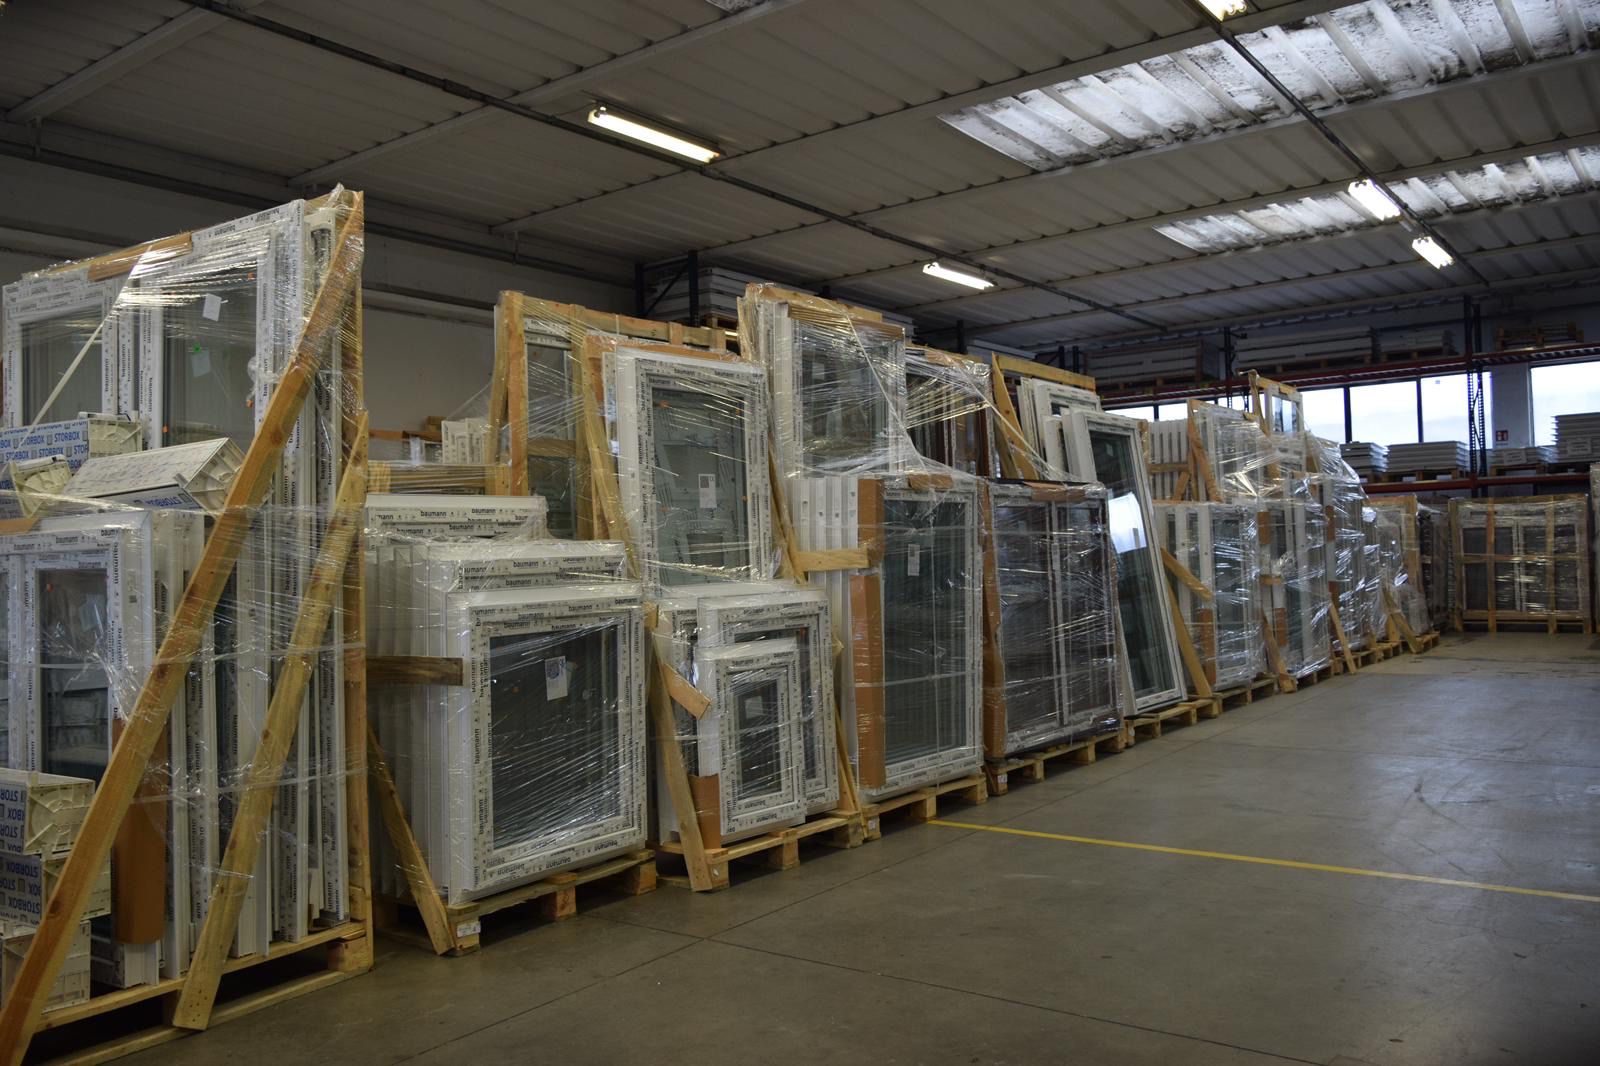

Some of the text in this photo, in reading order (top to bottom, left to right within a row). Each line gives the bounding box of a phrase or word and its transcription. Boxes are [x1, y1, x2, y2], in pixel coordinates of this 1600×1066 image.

[54, 431, 81, 442] STORBOX
[5, 450, 29, 460] STORBOX
[38, 447, 64, 458] STORBOX
[420, 510, 448, 518] baumann
[449, 524, 475, 532] baumann
[513, 561, 540, 569] baumann
[505, 579, 533, 587] baumann
[503, 621, 531, 629] baumann
[6, 860, 39, 878] STORBOX
[7, 896, 41, 915] STORBOX
